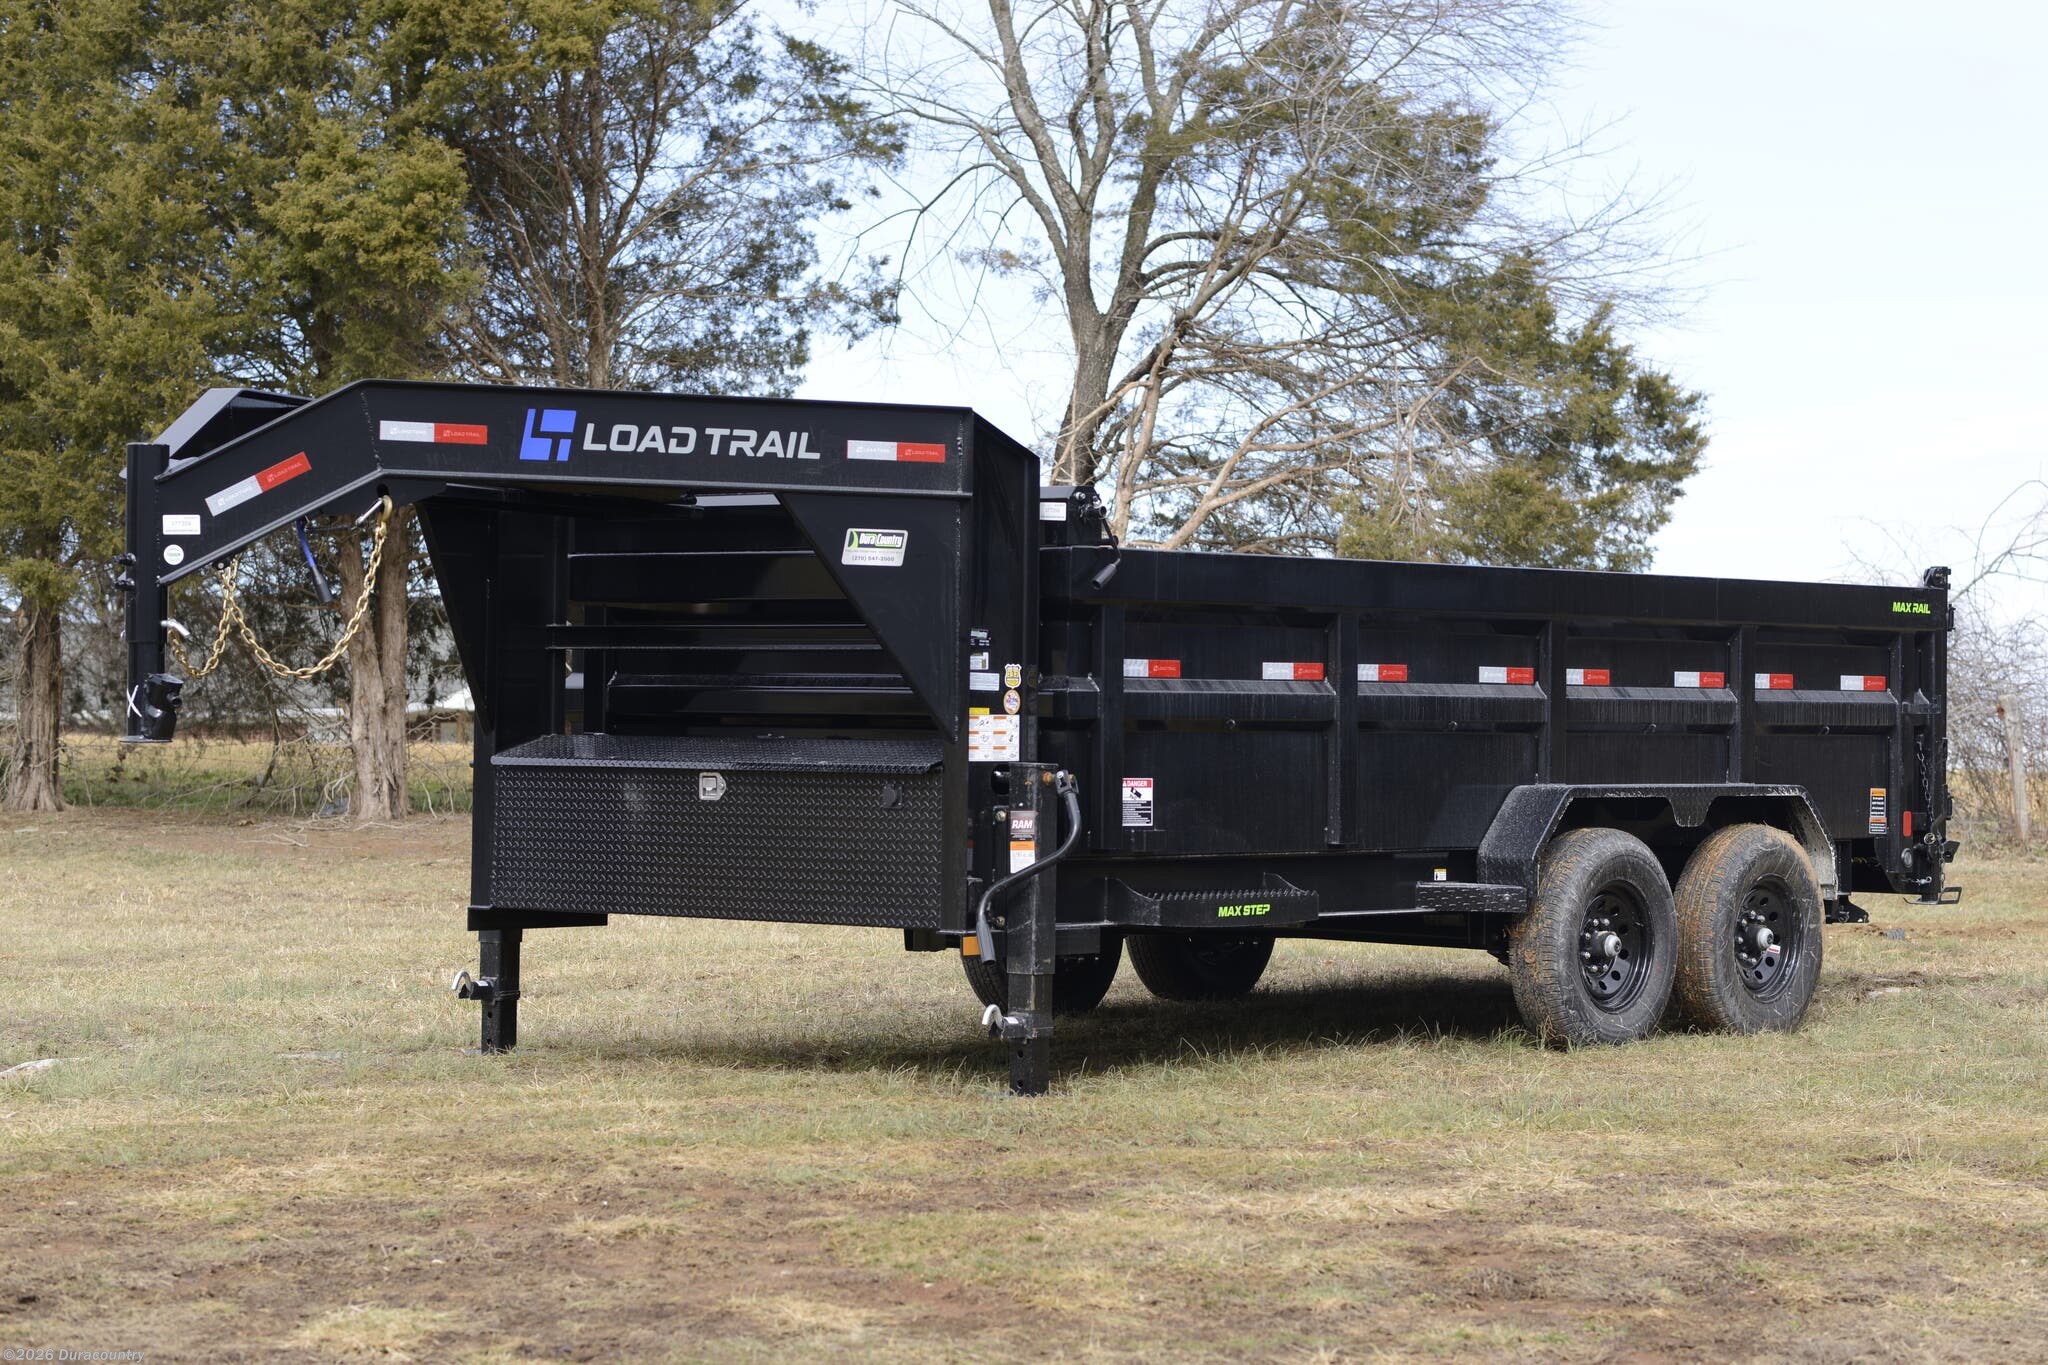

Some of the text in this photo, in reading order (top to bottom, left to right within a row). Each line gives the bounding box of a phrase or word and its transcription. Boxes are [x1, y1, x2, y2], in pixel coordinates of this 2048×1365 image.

[583, 423, 821, 460] LOAD TRAIL
[859, 532, 903, 548] Dura Country
[1893, 601, 1931, 614] MAX RAIL
[1012, 819, 1033, 829] RAM
[1218, 904, 1271, 917] MAX STEP
